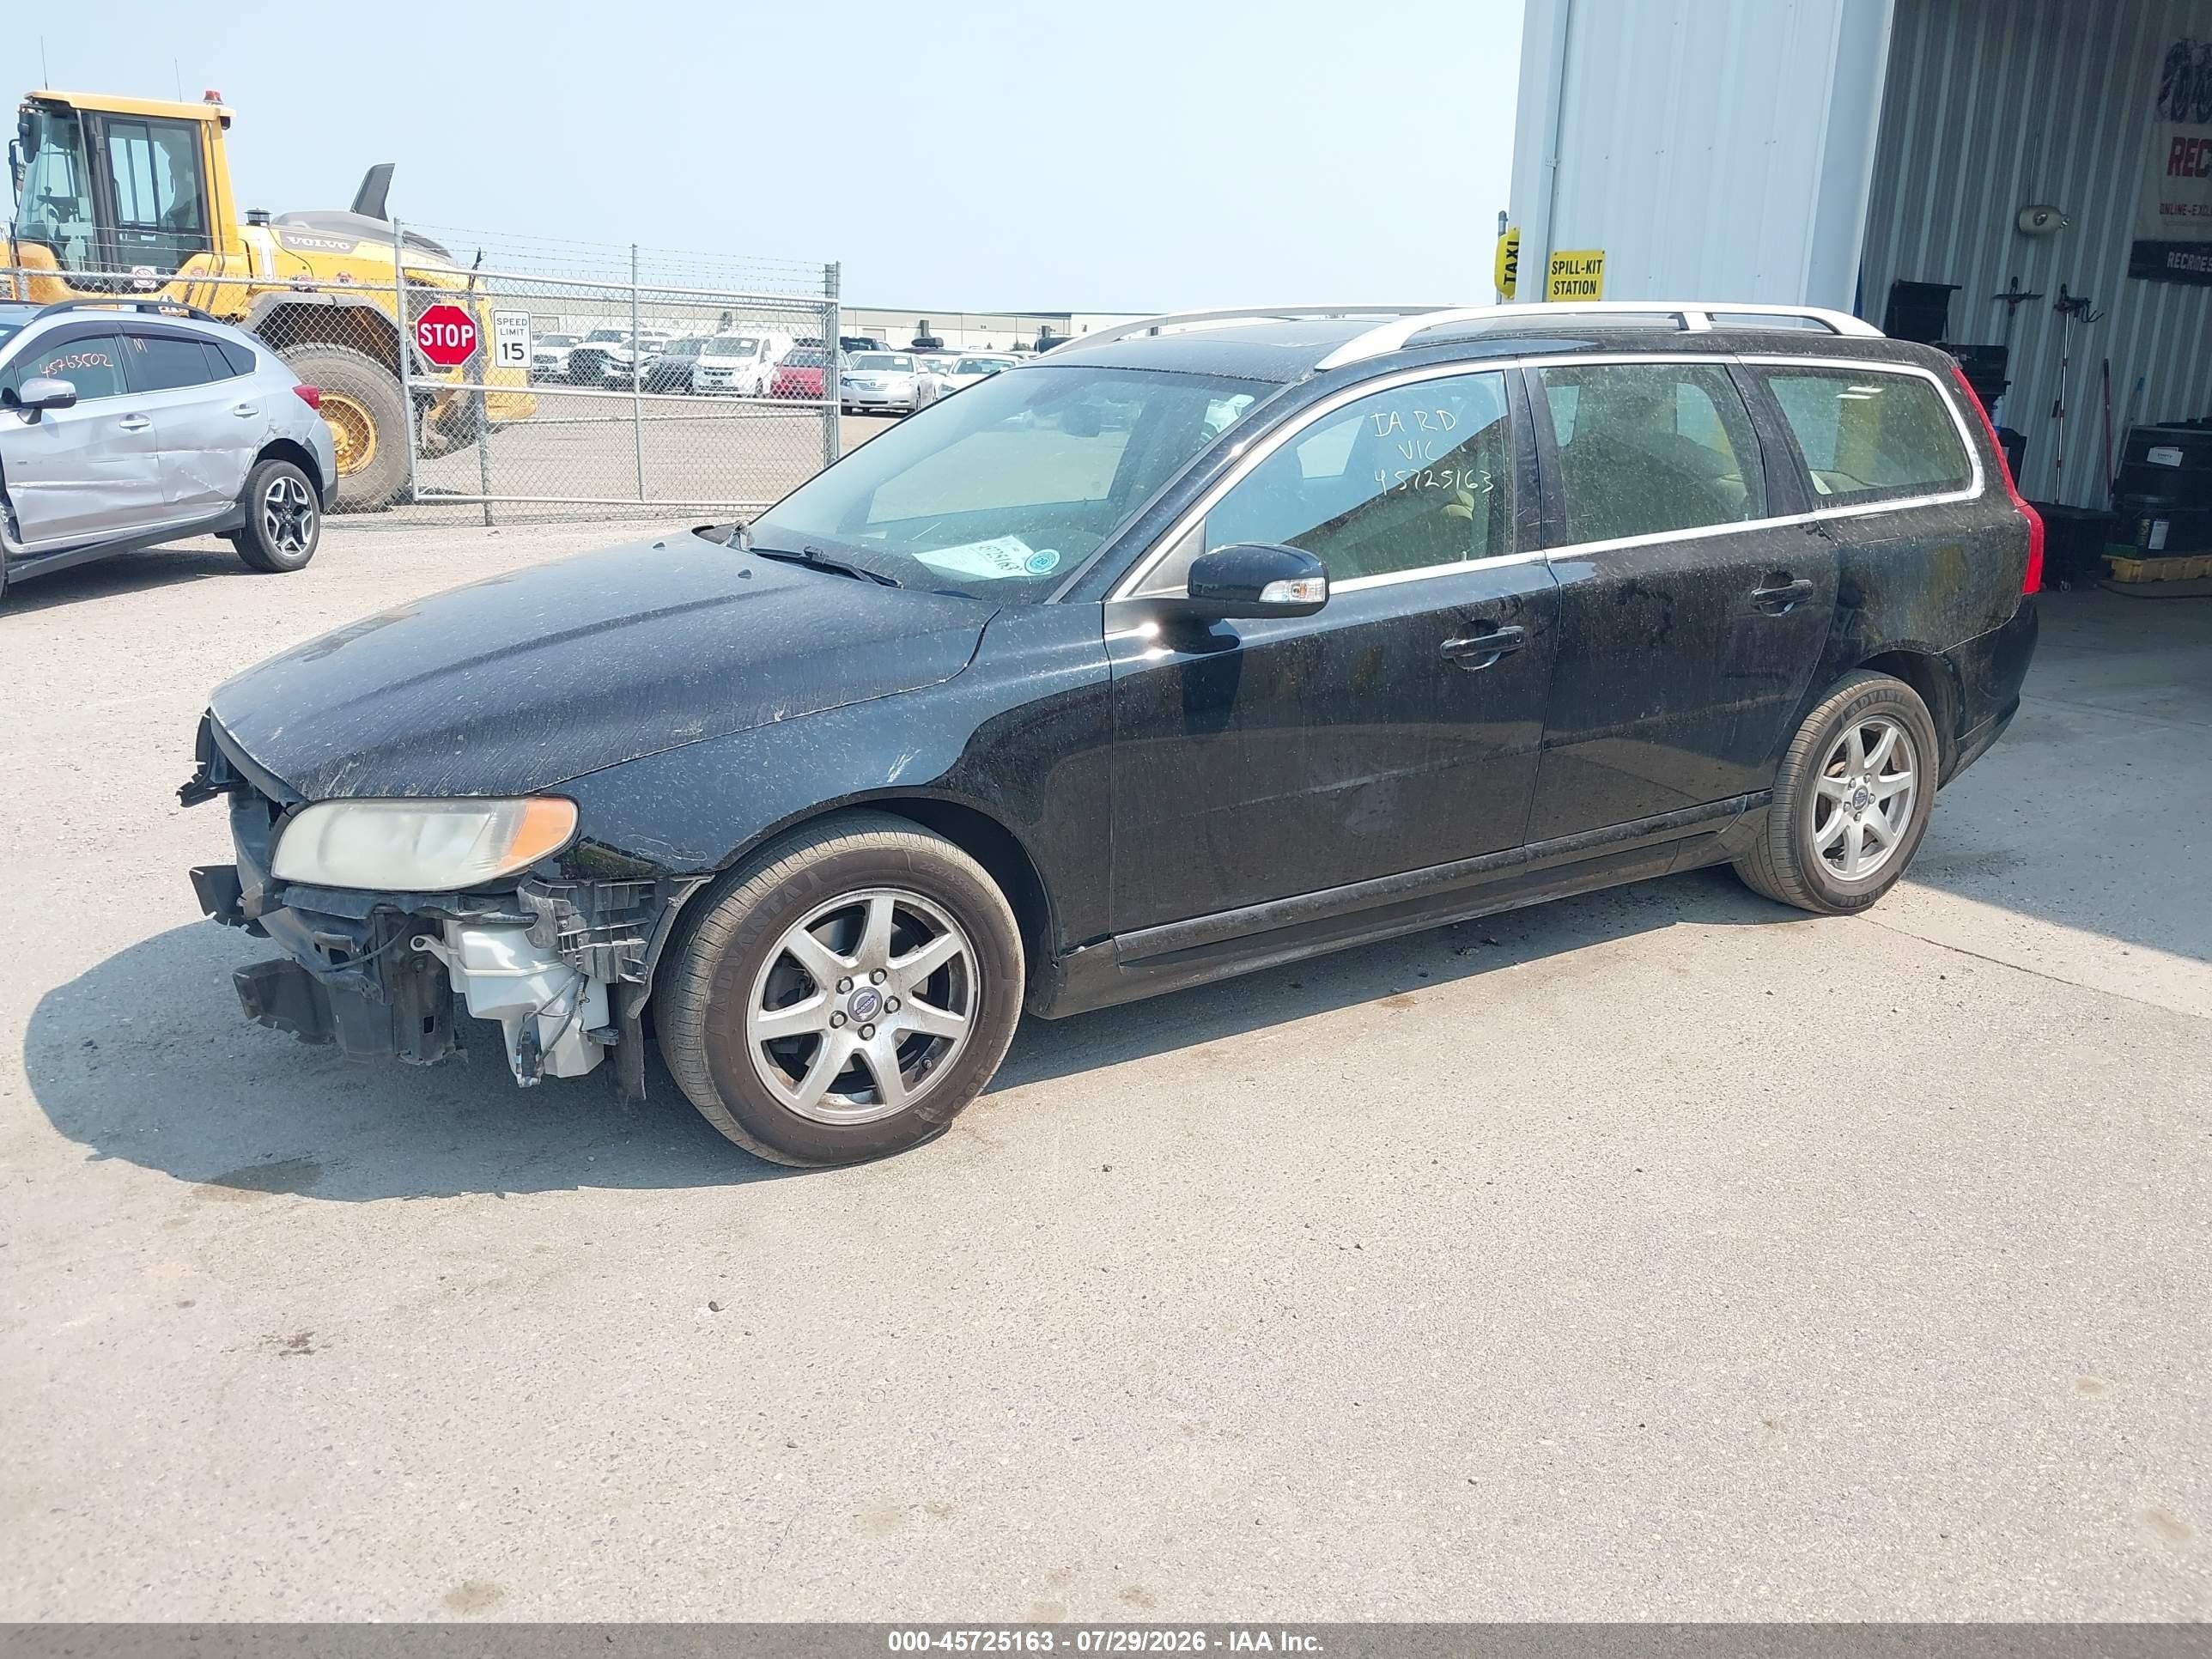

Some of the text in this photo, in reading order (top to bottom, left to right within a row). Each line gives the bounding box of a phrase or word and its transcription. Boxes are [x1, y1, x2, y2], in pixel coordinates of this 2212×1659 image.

[286, 236, 351, 250] VOLVO
[1504, 240, 1520, 285] TAXI
[1552, 259, 1603, 276] SPILL-KIT
[1553, 280, 1597, 295] STATION
[496, 317, 528, 326] SPEED
[420, 323, 474, 348] STOP
[500, 328, 525, 337] LIMIT
[501, 342, 525, 361] 15
[40, 353, 114, 378] 45763502
[1398, 440, 1438, 462] VIC
[1373, 469, 1495, 495] 45725163
